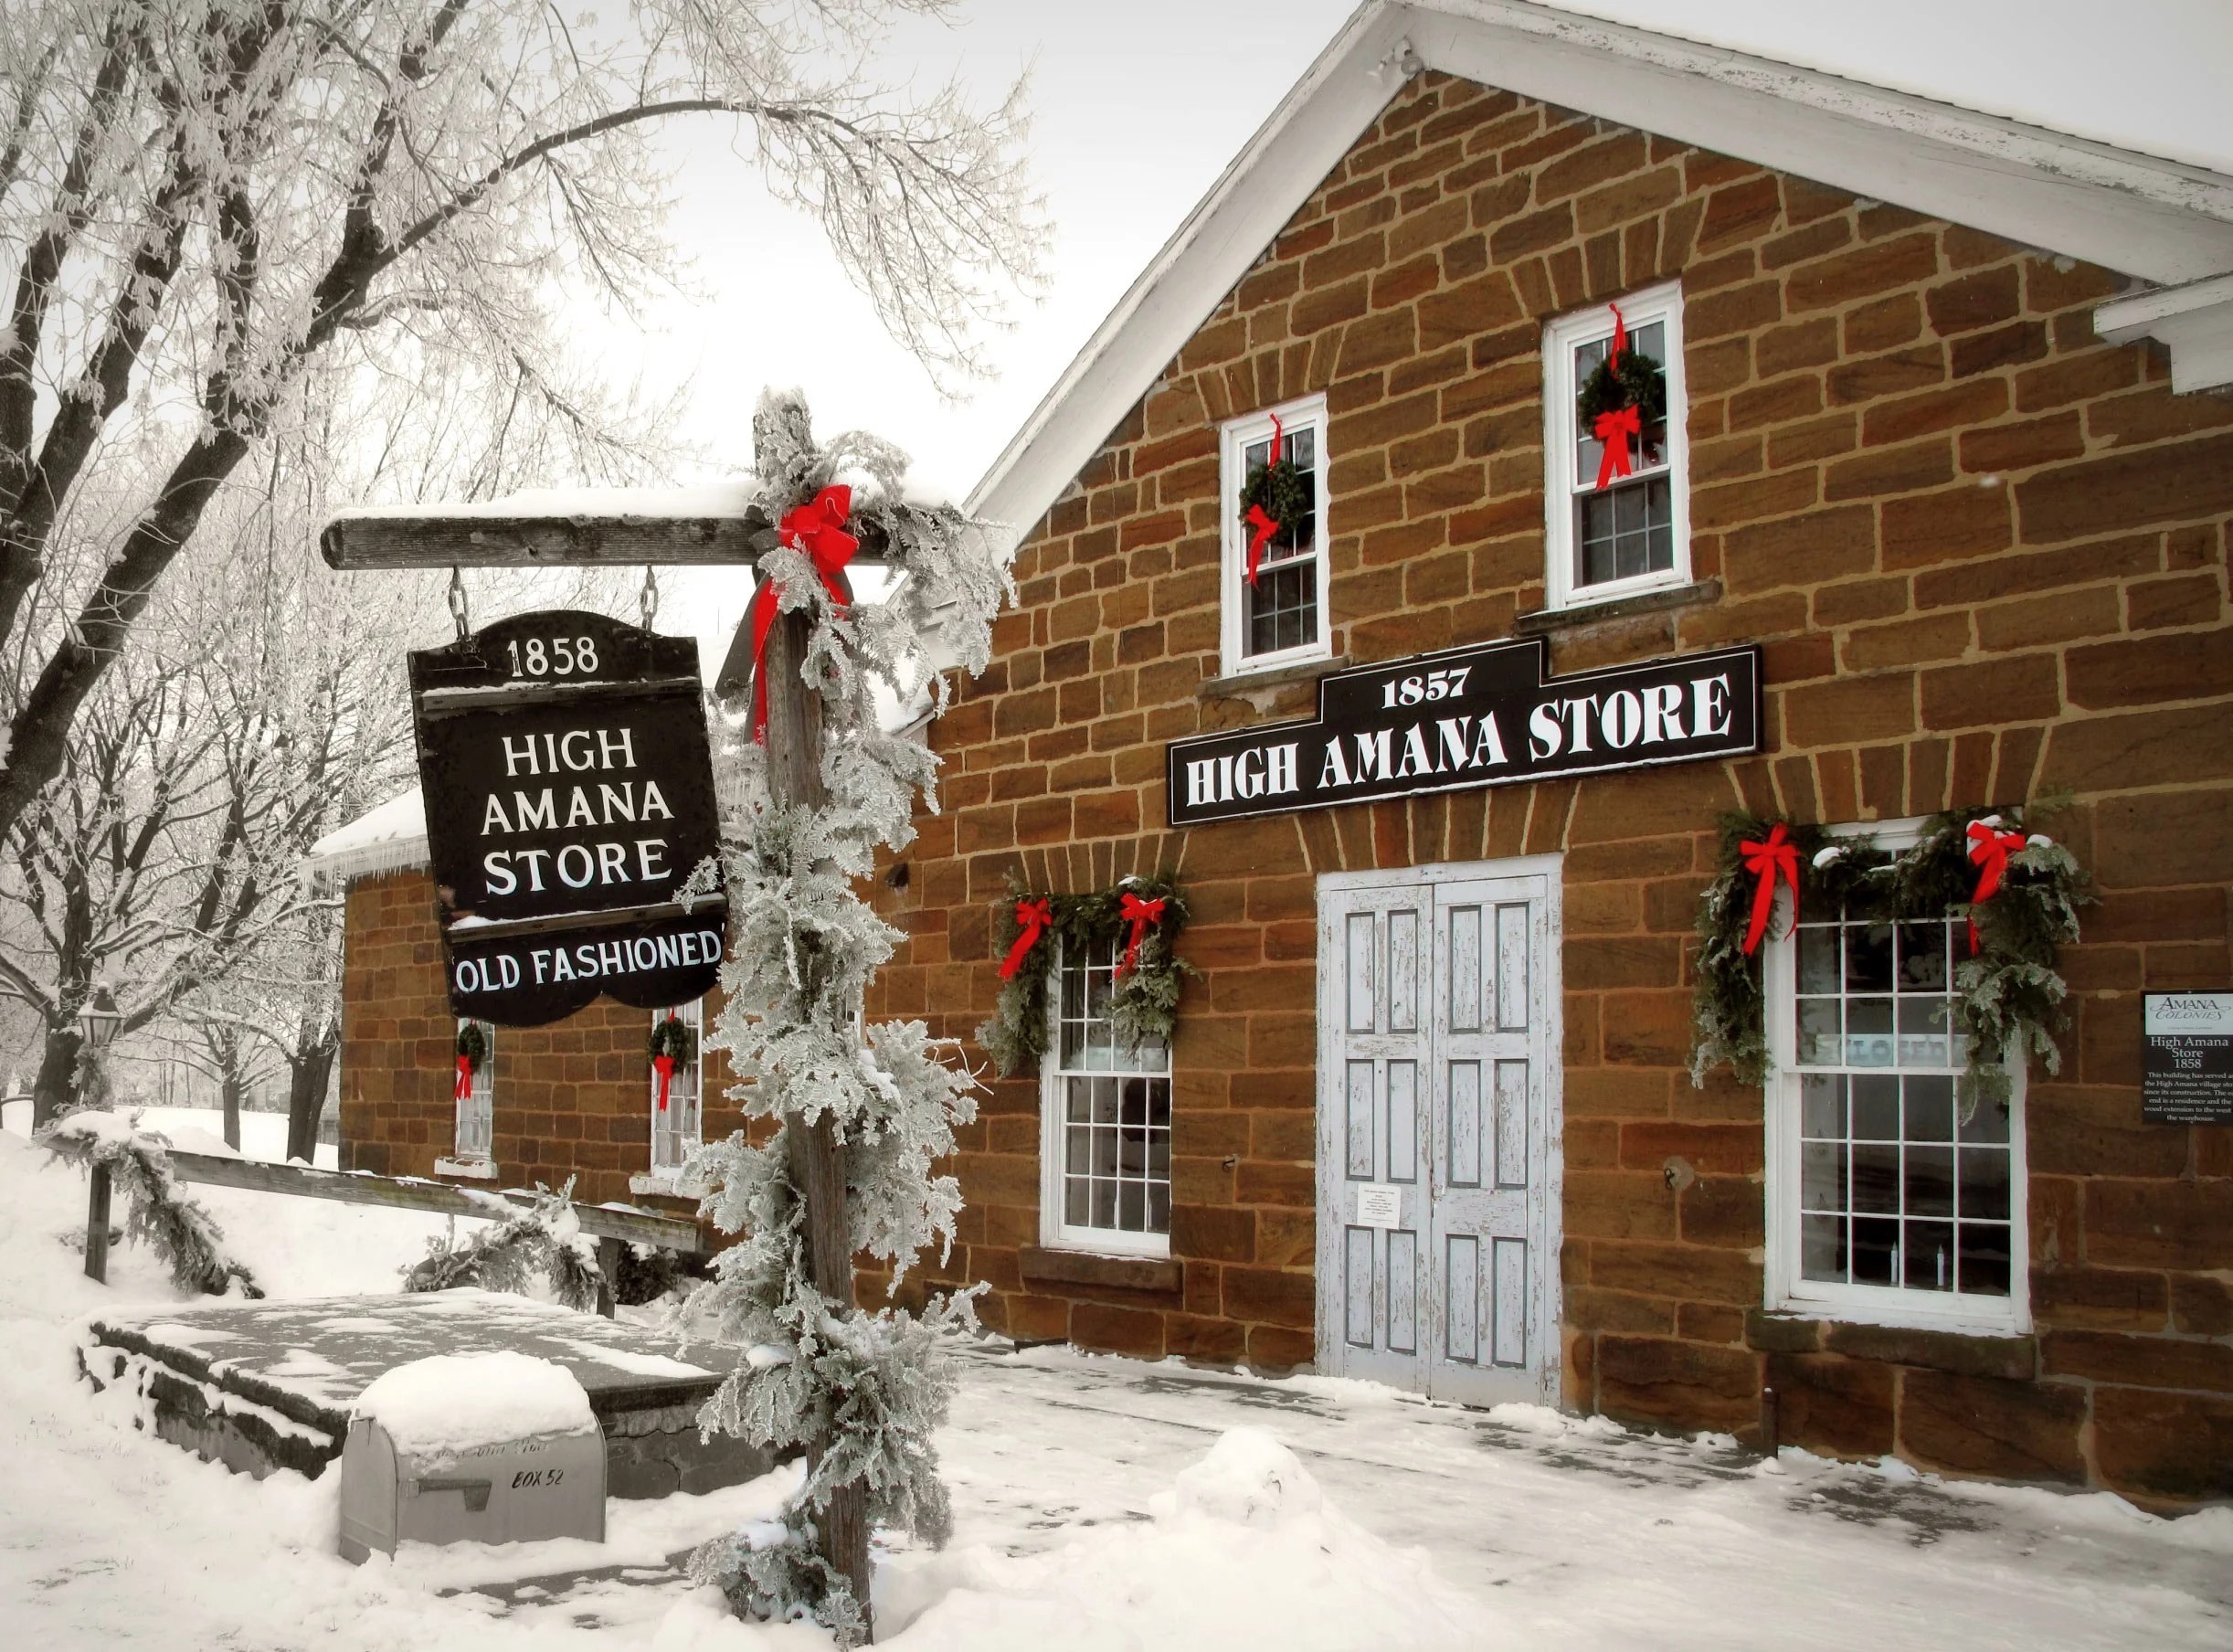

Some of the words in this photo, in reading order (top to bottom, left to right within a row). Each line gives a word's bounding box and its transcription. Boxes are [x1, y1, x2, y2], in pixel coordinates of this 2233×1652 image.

[507, 637, 599, 677] 1858
[1381, 665, 1472, 709] 1857
[502, 728, 638, 777] HIGH
[1186, 742, 1299, 808] HIGH
[1317, 711, 1508, 789] AMANA
[1528, 672, 1731, 760] STORE
[481, 780, 675, 835] AMANA
[483, 839, 672, 895] STORE
[456, 955, 520, 993] OLD
[531, 930, 723, 985] FASHIONED
[2151, 1036, 2181, 1050] High
[2185, 1036, 2229, 1047] Amana
[2171, 1048, 2204, 1058] Store
[2156, 1080, 2173, 1088] High
[2164, 1072, 2191, 1080] building
[2175, 1059, 2202, 1069] 1858
[512, 1470, 543, 1488] BOX
[545, 1469, 564, 1487] 52
